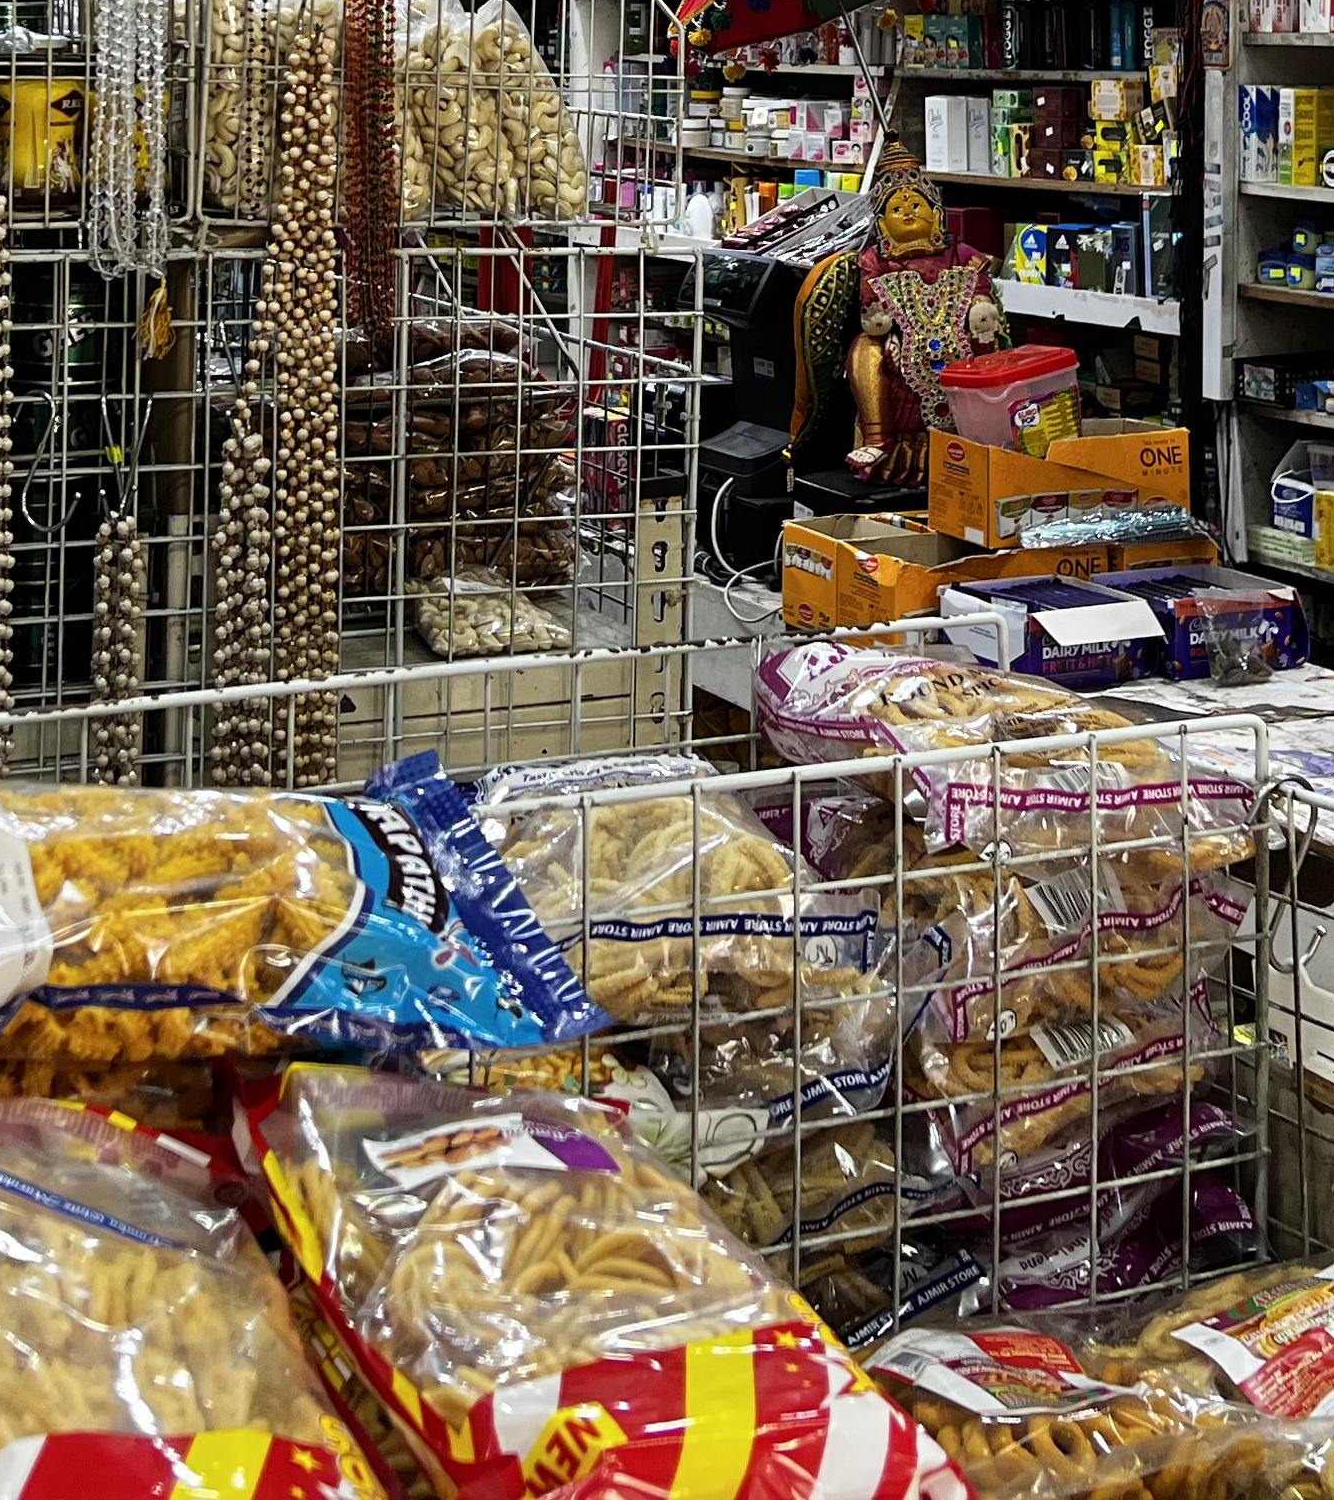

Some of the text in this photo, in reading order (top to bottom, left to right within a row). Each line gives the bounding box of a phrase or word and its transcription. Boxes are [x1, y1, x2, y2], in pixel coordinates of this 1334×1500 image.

[1021, 416, 1036, 425] POP
[1139, 446, 1183, 468] ONE
[1142, 467, 1183, 477] MINUTE
[1056, 556, 1101, 576] ONE
[1190, 626, 1259, 644] DAIRY MILK
[1042, 642, 1112, 659] DAIRY MILK
[819, 727, 866, 739] AJMIR STORE
[1048, 795, 1081, 807] AJMIR
[949, 802, 962, 840] STORE
[592, 923, 663, 937] AJMIR STORE
[1110, 916, 1139, 927] AJMIR
[834, 1072, 867, 1089] STORE
[917, 1264, 980, 1307] AJMIR STORE
[847, 1321, 880, 1346] AJMIR
[526, 1418, 602, 1498] NEW
